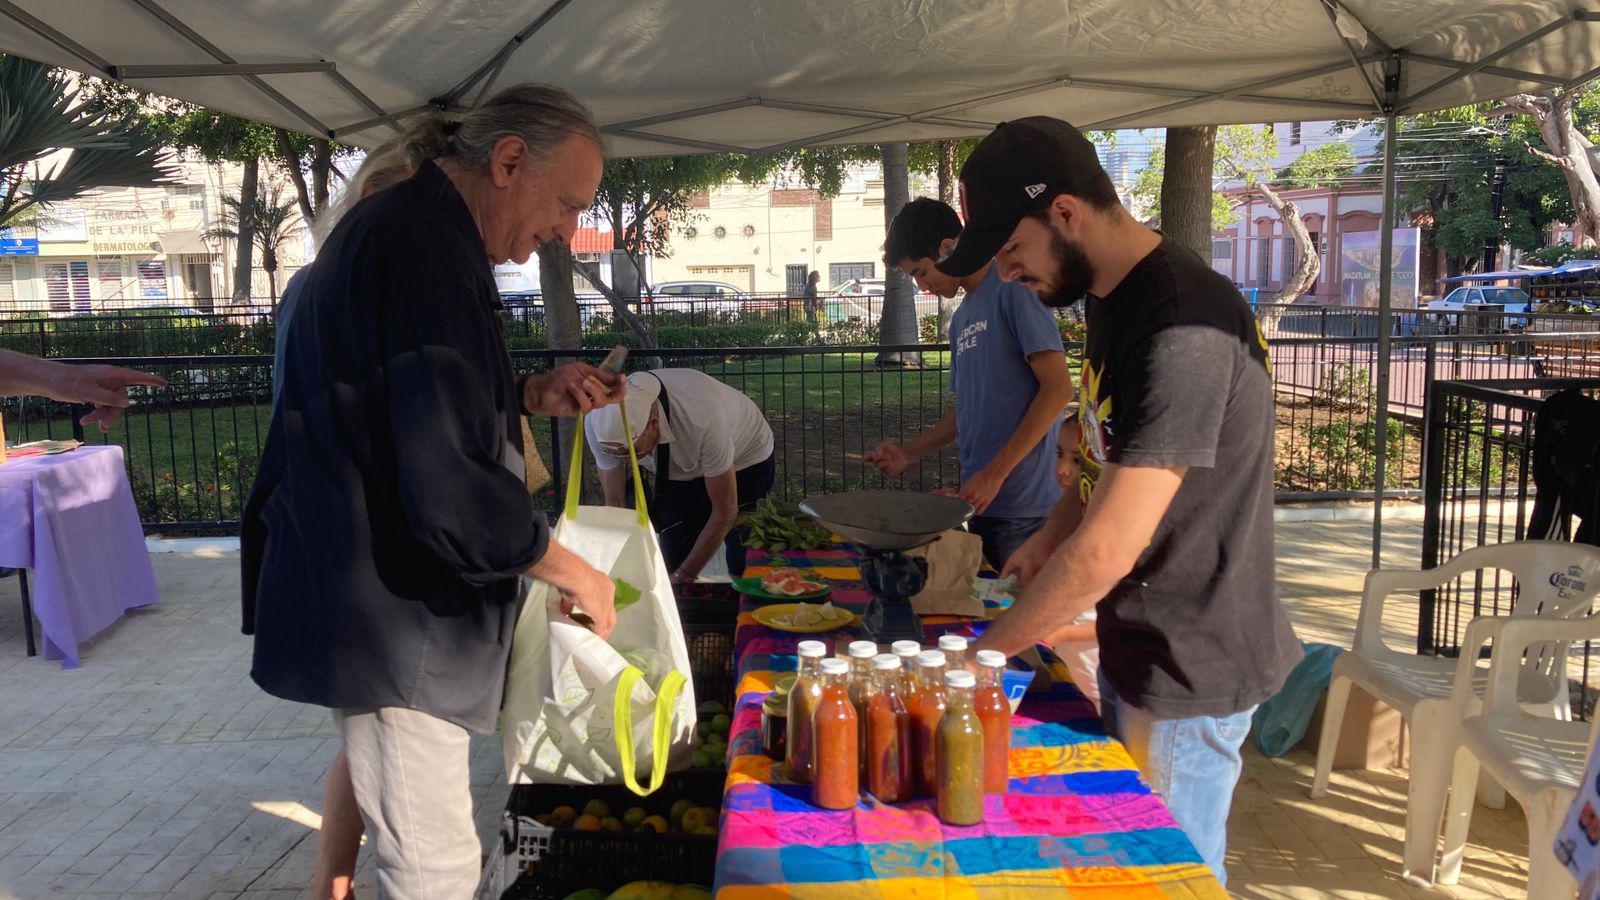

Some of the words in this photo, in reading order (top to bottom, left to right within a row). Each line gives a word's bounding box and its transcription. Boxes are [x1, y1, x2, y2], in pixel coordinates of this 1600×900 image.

[94, 210, 149, 220] FARMACIA
[89, 226, 103, 235] DE
[109, 226, 124, 235] LA
[131, 225, 155, 235] PIEL
